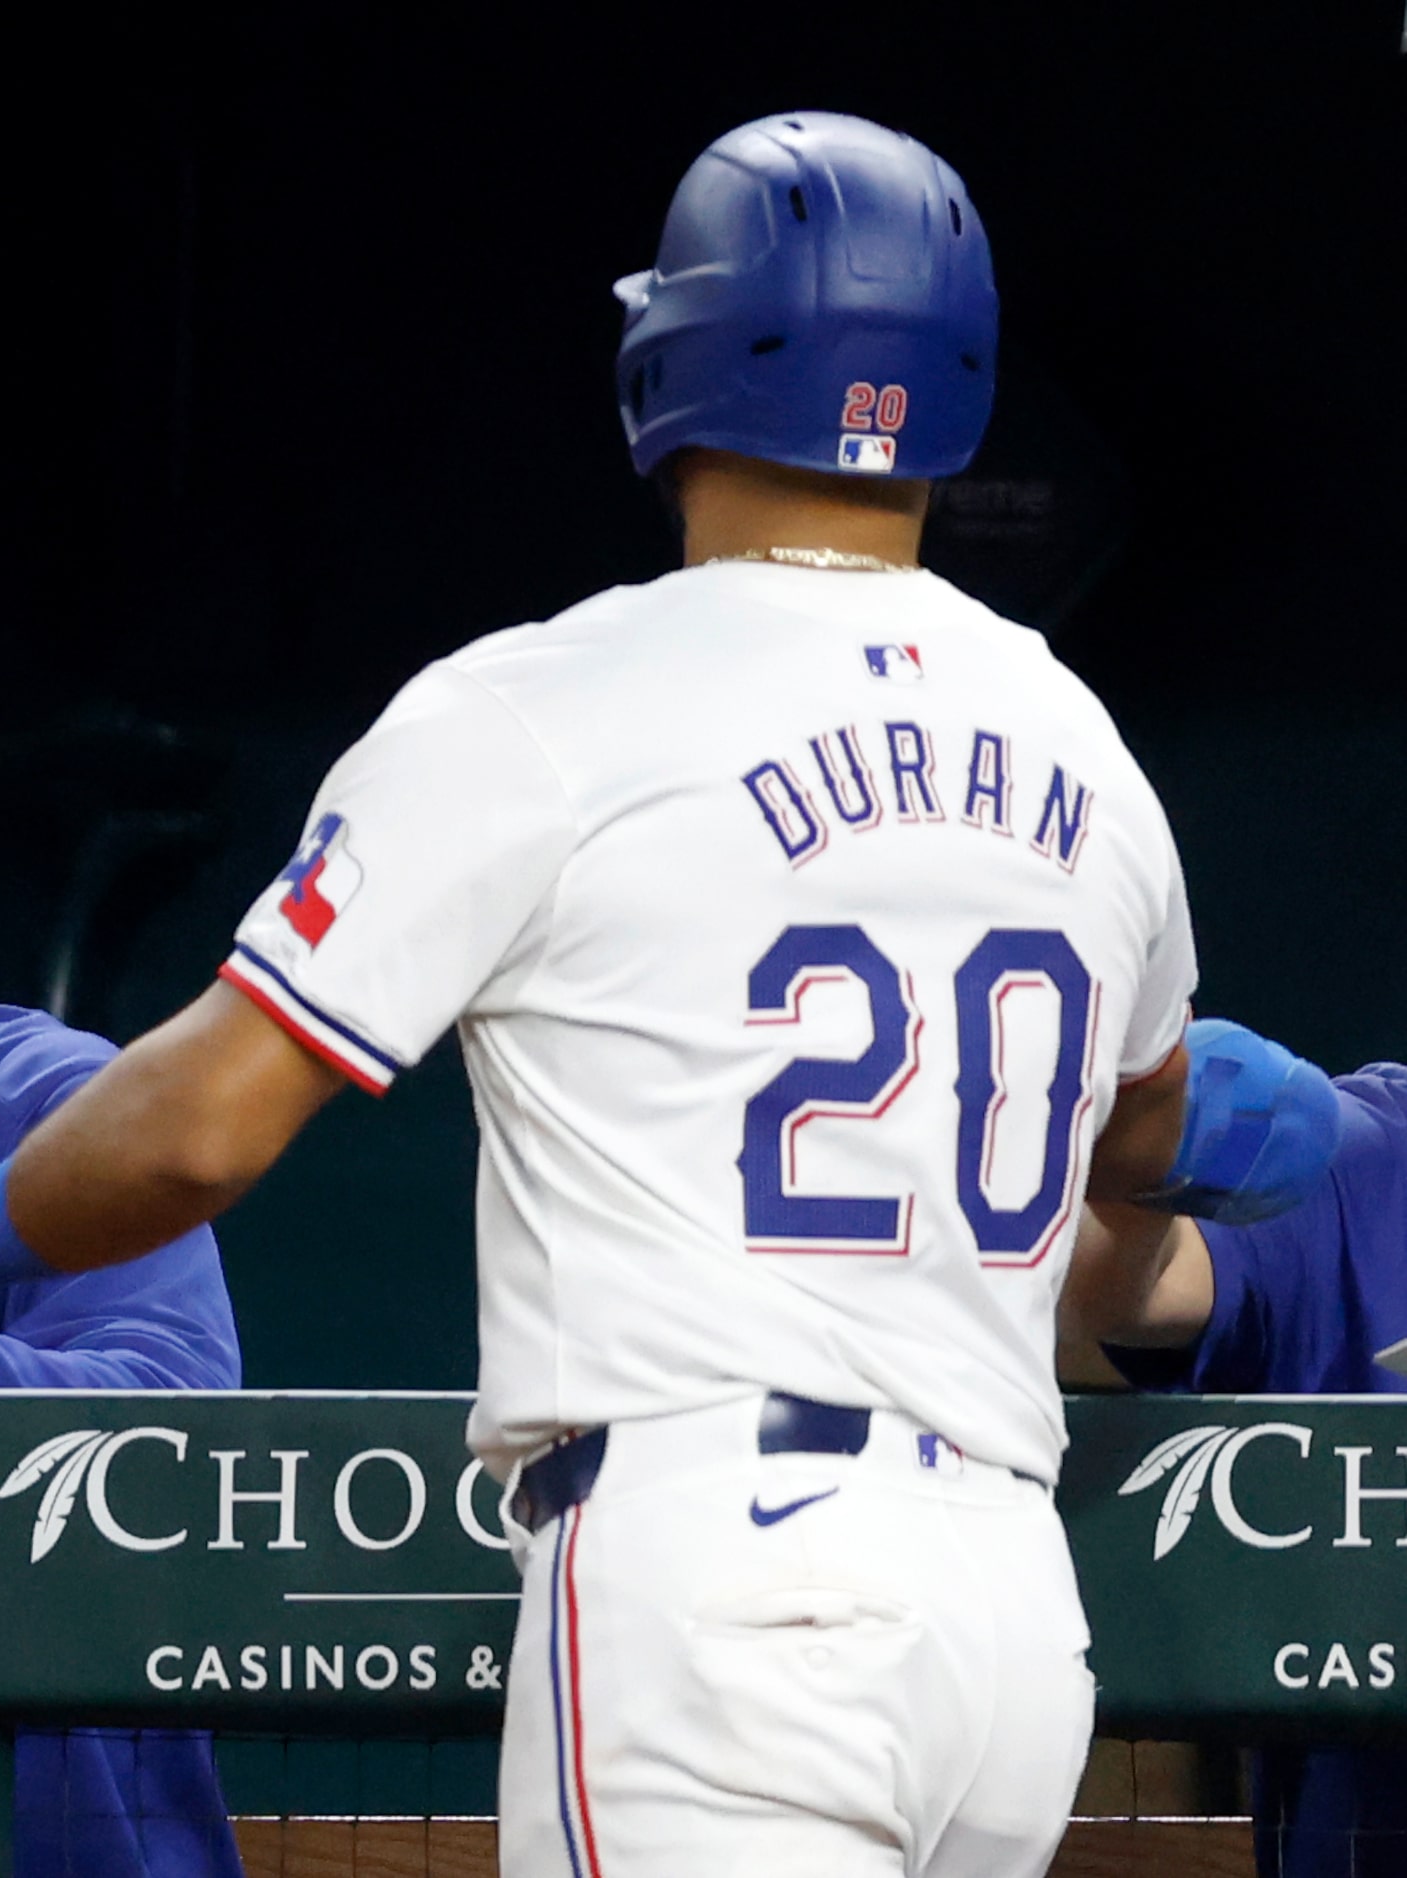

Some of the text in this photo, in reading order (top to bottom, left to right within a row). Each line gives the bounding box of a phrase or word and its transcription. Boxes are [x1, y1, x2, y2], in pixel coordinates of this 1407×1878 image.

[841, 380, 908, 434] 20
[742, 721, 1094, 874] DURAN
[735, 923, 1102, 1268] 20
[145, 1644, 503, 1691] CASINOS &
[1273, 1642, 1396, 1689] CAS
